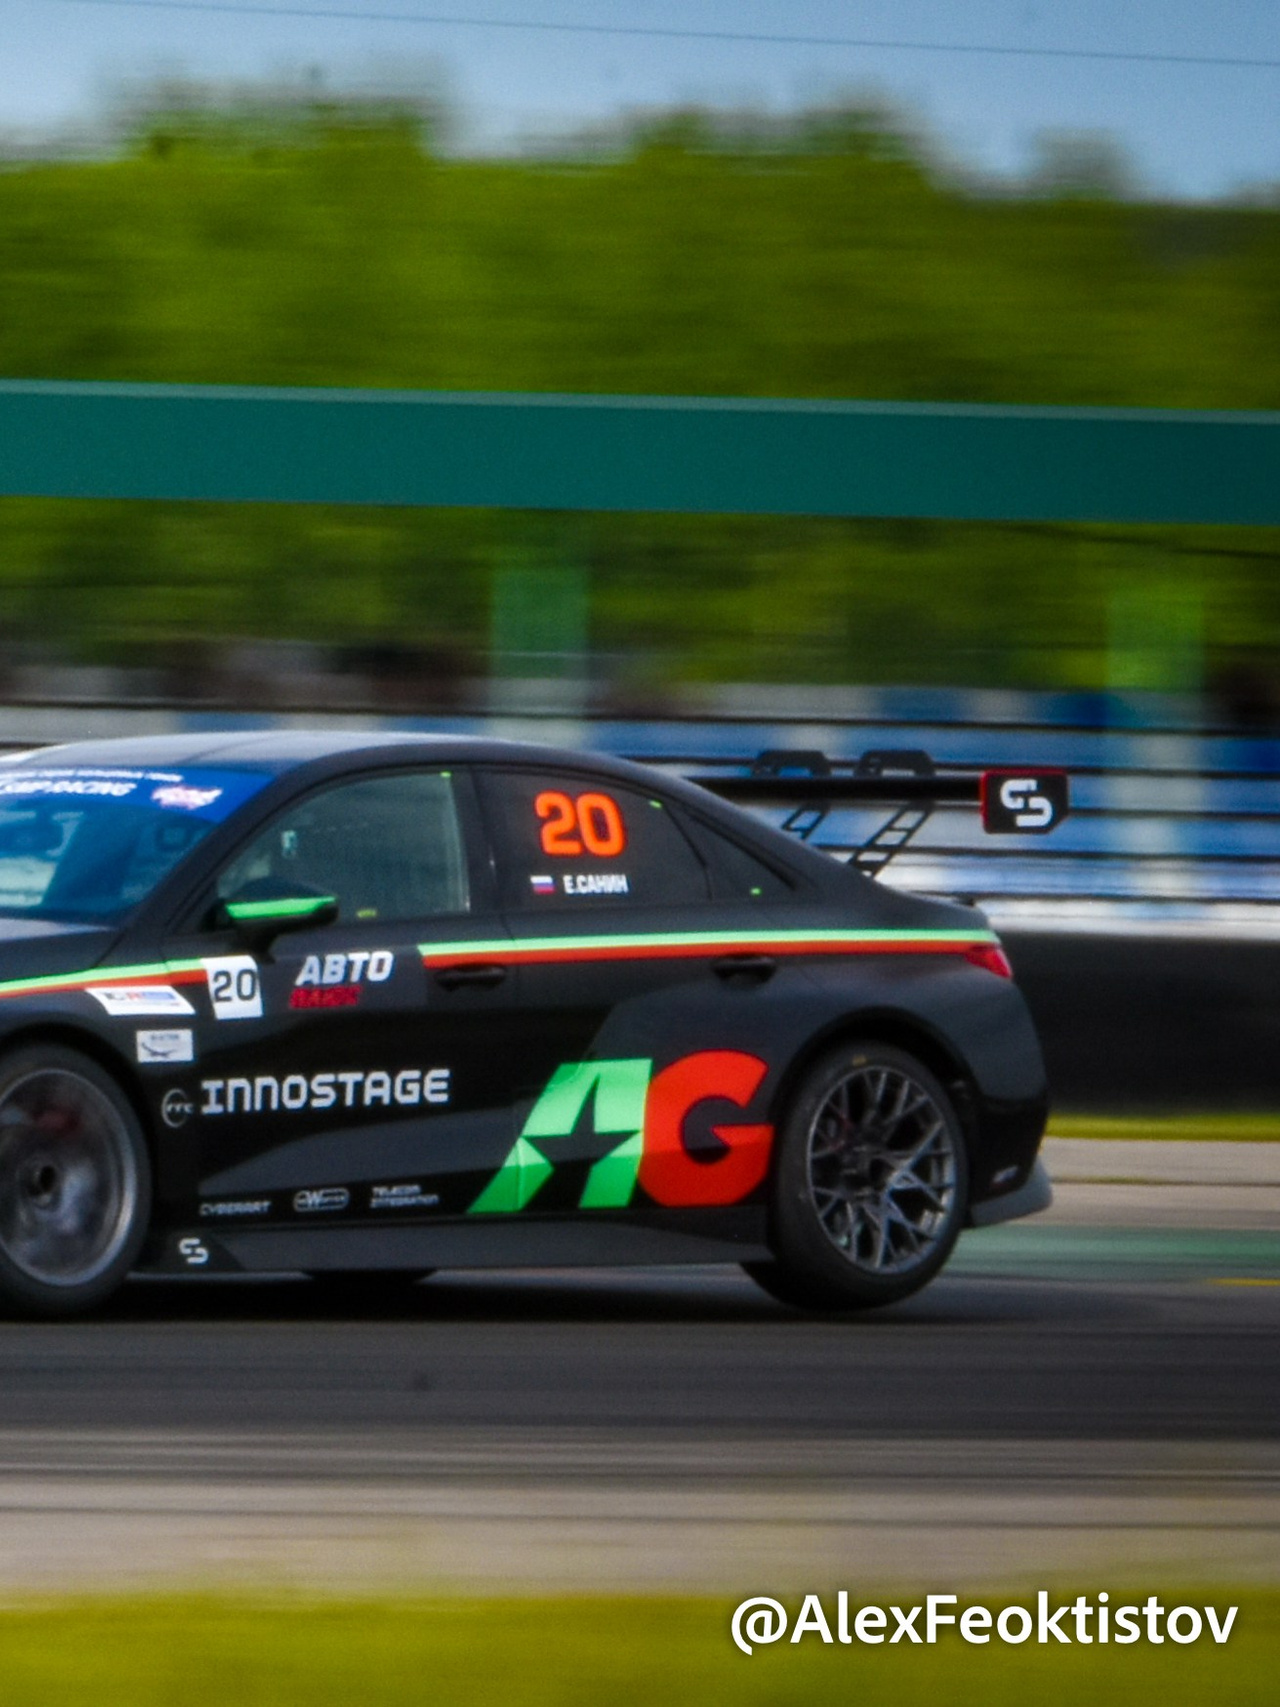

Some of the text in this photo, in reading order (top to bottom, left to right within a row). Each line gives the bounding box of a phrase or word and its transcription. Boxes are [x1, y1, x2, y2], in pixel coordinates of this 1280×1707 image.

[533, 789, 626, 856] 20
[562, 874, 629, 894] Е.САНИН
[213, 968, 258, 1003] 20
[294, 950, 394, 987] АВТО
[201, 1068, 451, 1115] INNOSTAGE
[466, 1048, 775, 1214] AG
